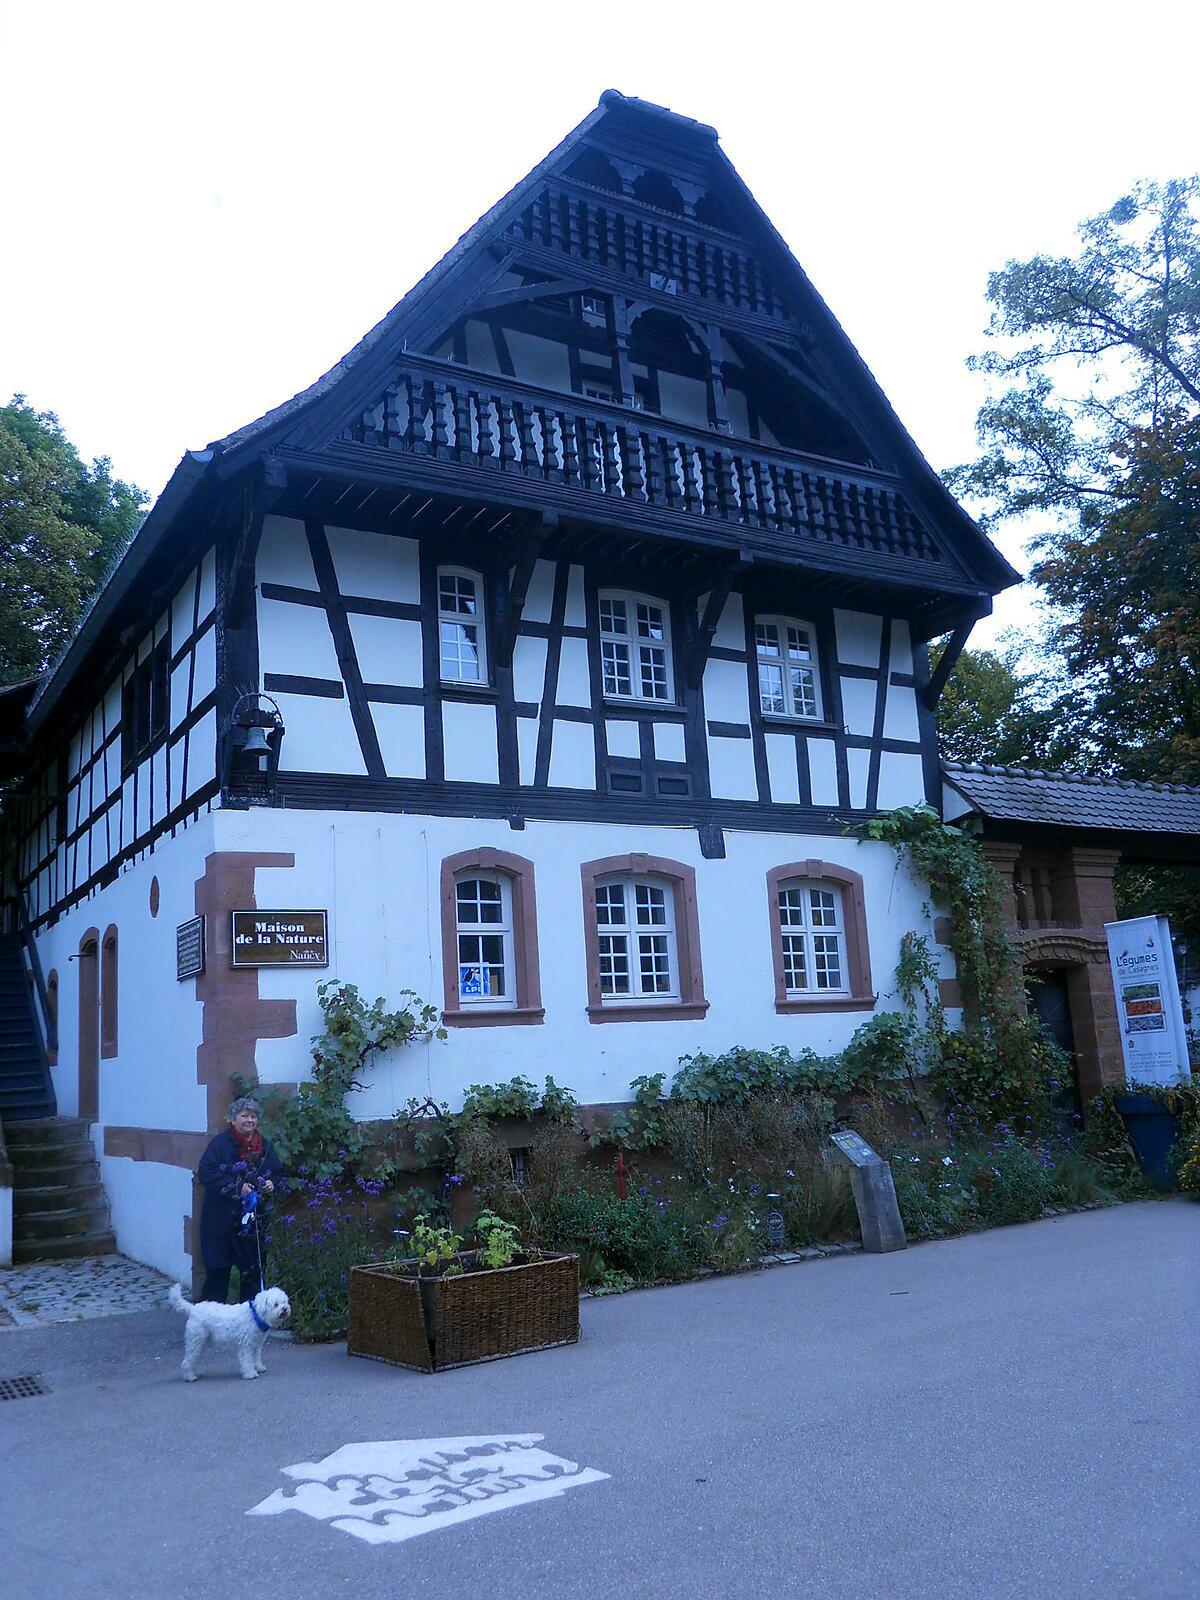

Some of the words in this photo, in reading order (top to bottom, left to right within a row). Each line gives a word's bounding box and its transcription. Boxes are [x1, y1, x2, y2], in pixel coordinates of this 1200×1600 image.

[255, 922, 305, 932] Maison
[236, 934, 253, 944] de
[257, 933, 271, 944] la
[275, 933, 324, 944] Nature
[289, 949, 323, 961] Nancy
[1116, 951, 1158, 968] Légumes
